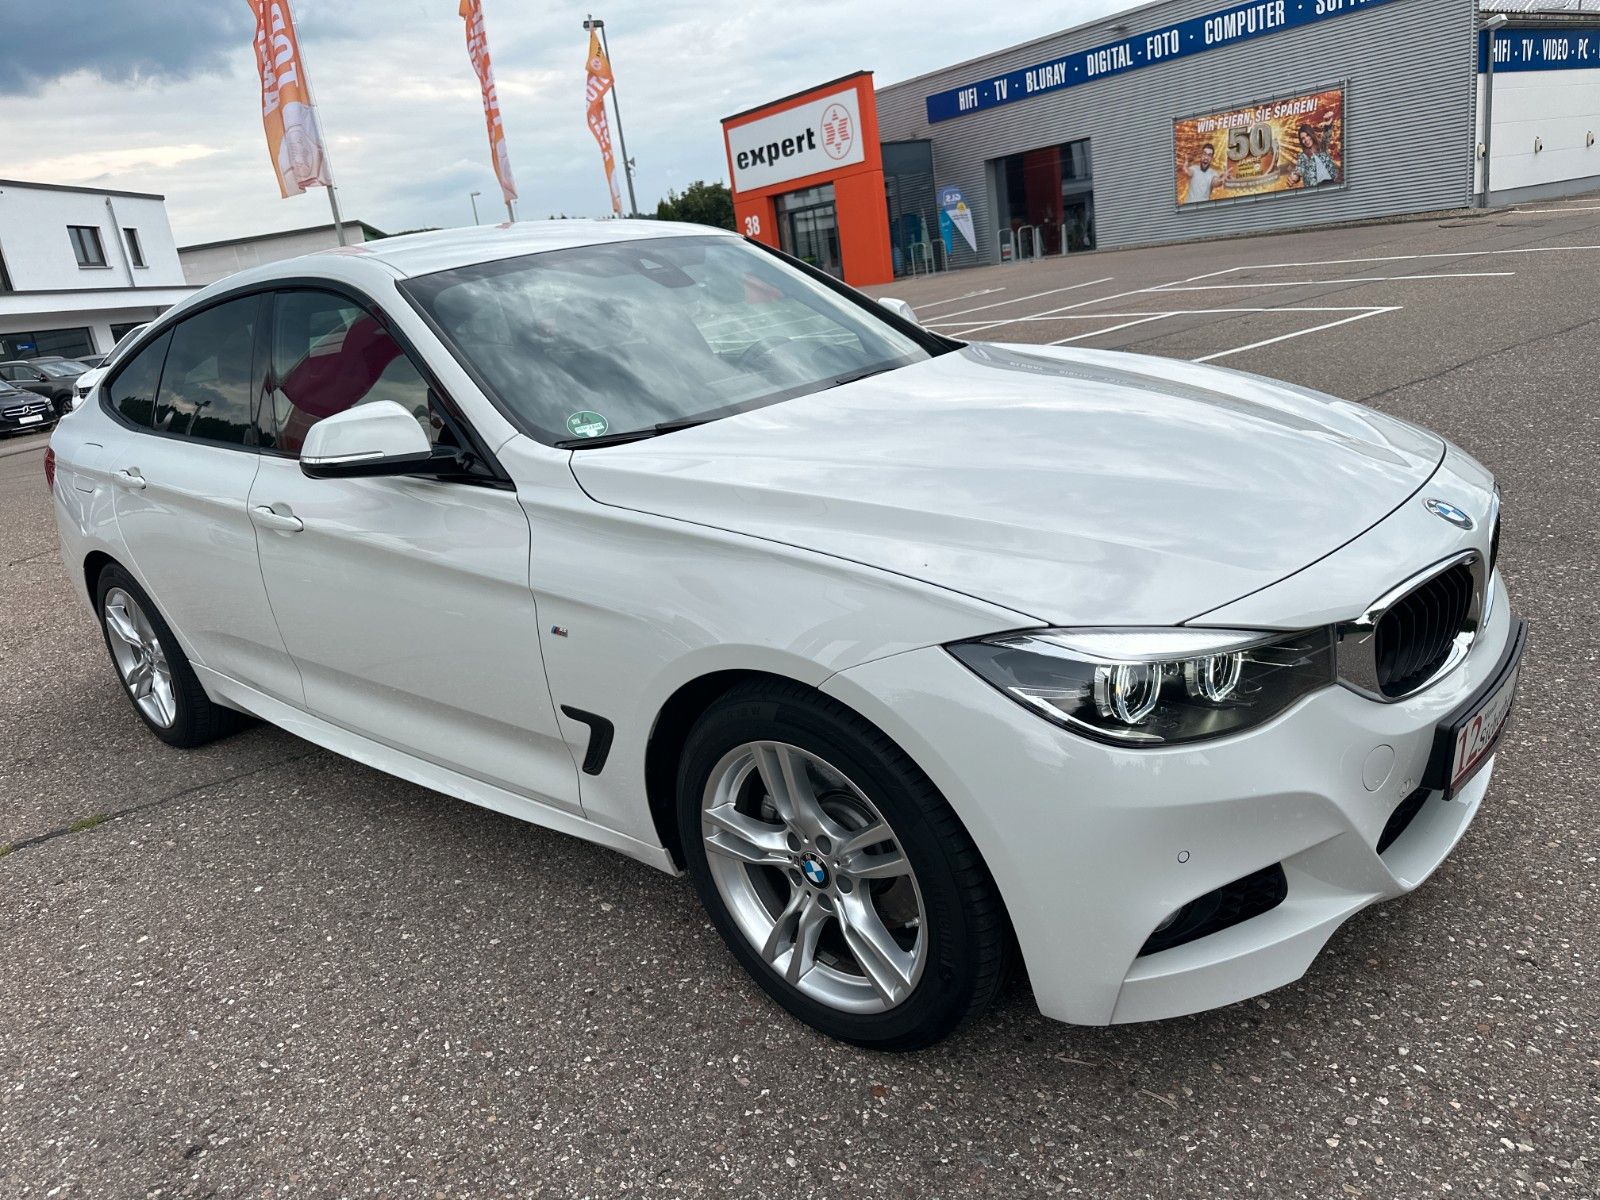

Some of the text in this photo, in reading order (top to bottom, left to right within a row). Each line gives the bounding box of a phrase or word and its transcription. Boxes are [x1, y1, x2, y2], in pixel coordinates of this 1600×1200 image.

[958, 87, 979, 111] HIFI
[994, 79, 1008, 101] TV
[1025, 61, 1067, 93] BLURAY
[1086, 43, 1133, 76] DIGITAL
[1146, 29, 1179, 60] FOTO
[1204, 0, 1286, 45] COMPUTER
[1522, 39, 1533, 61] TV
[1542, 38, 1569, 60] VIDEO
[1577, 38, 1589, 60] PC
[1197, 119, 1216, 133] WIR
[1255, 108, 1272, 123] SIE
[1274, 98, 1318, 119] SPAREN!
[736, 127, 816, 170] expert
[1227, 122, 1272, 162] 50
[744, 215, 761, 237] 38
[1454, 715, 1482, 778] 12
